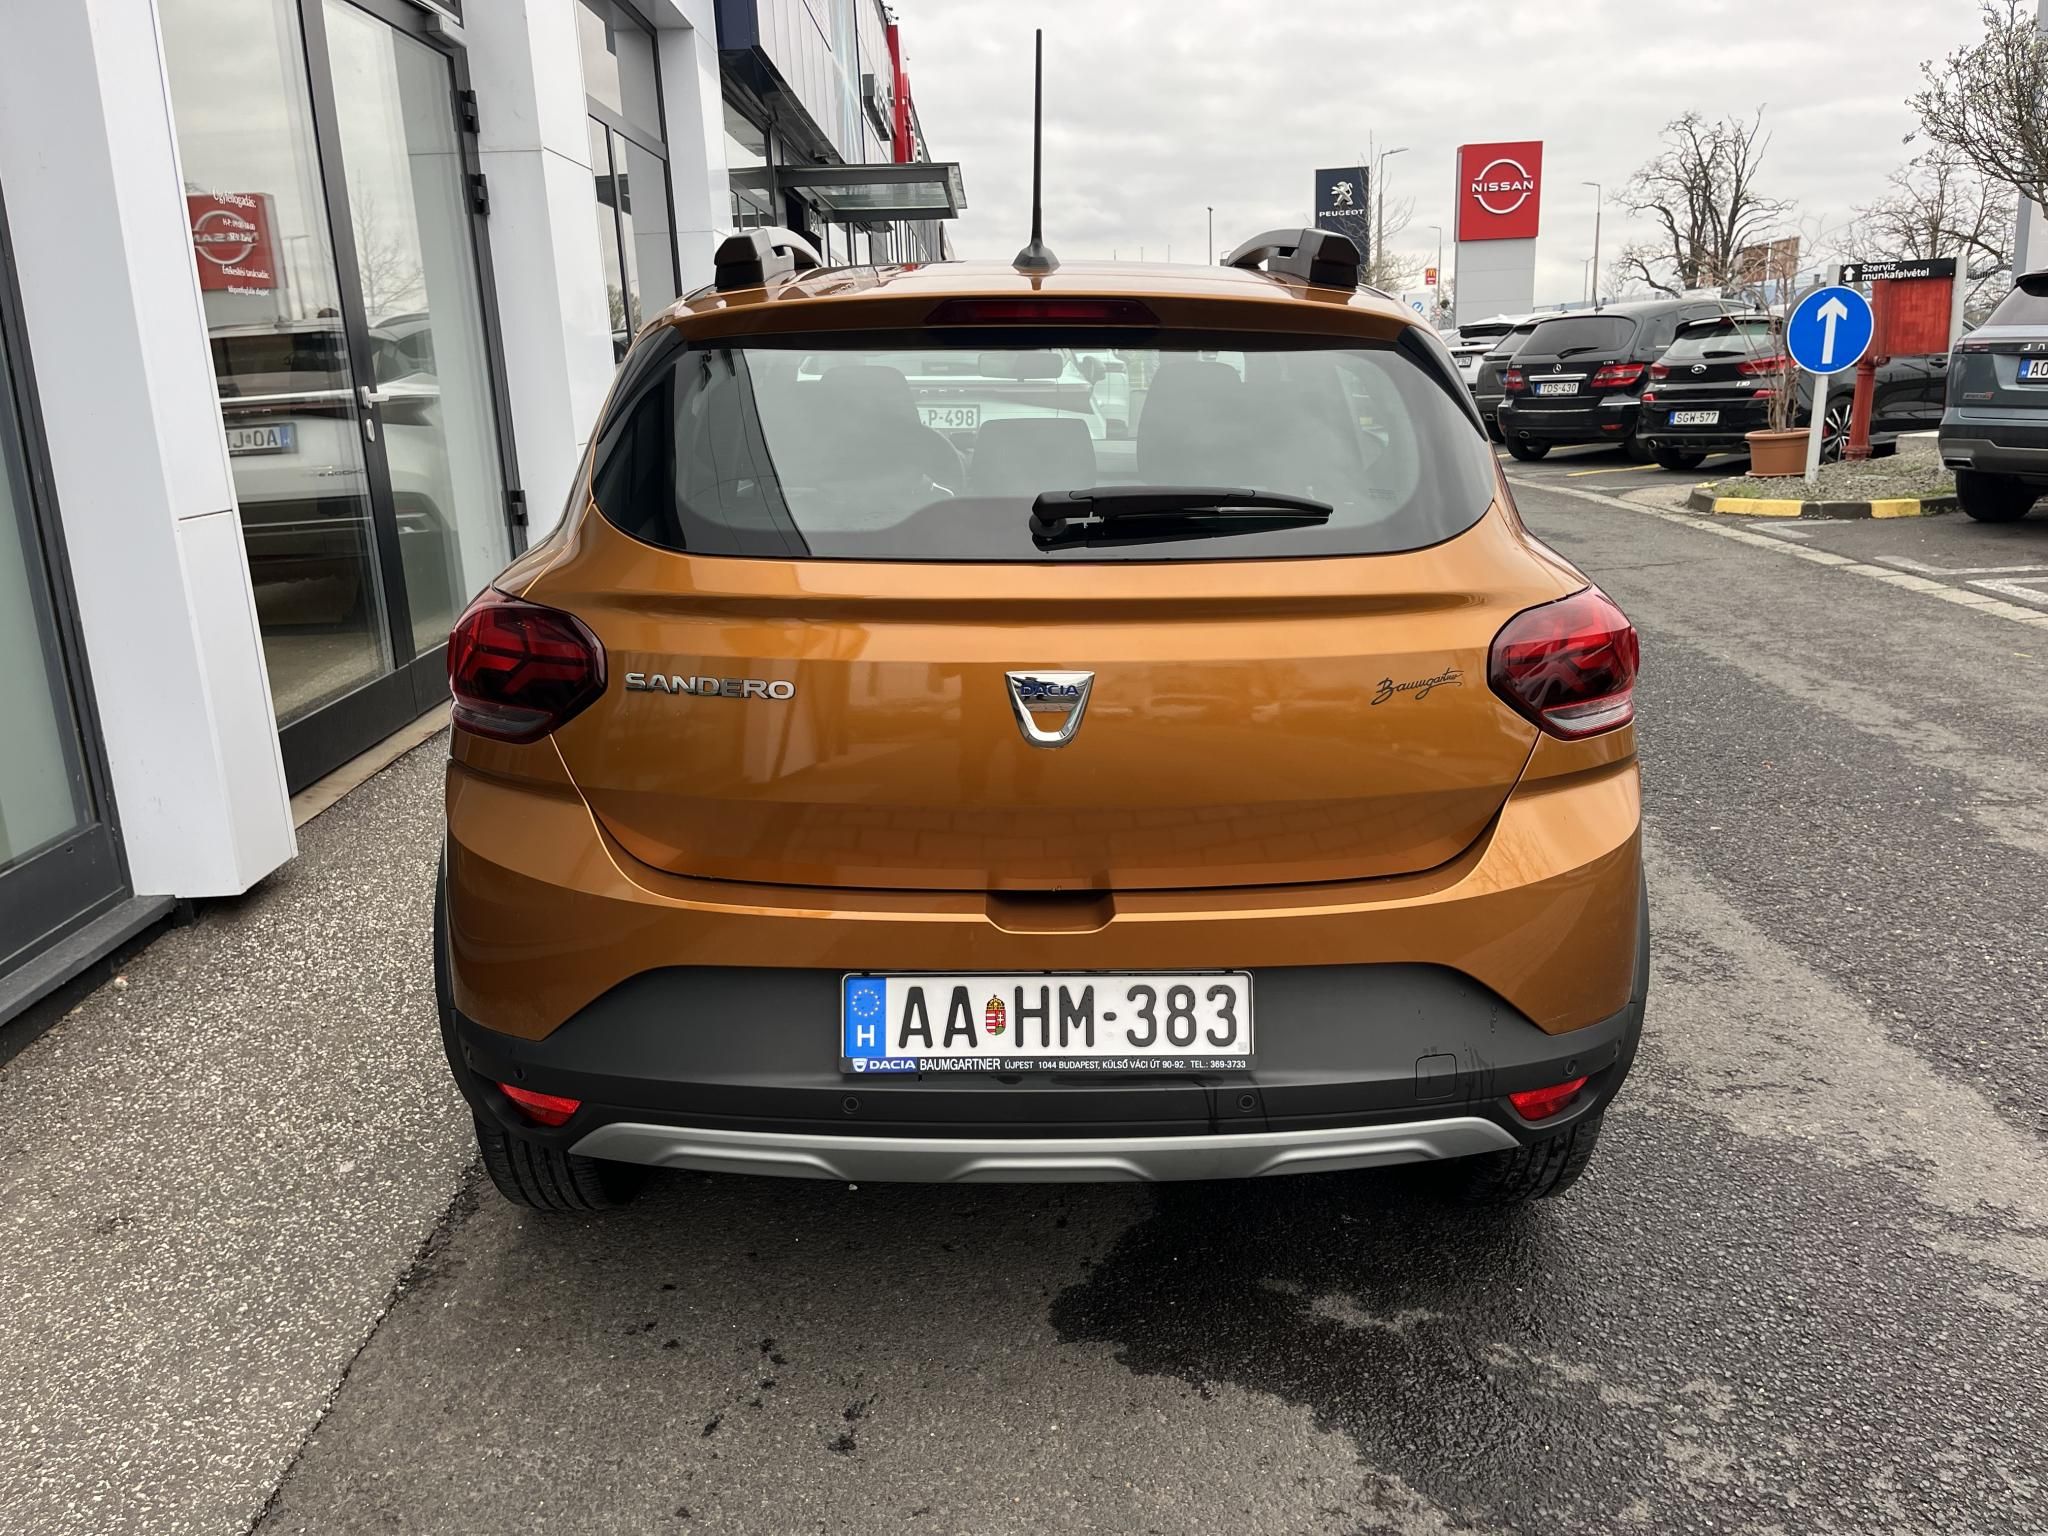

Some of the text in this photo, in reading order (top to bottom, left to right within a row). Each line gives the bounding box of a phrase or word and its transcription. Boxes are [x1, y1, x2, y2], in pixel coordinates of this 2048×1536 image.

[1472, 180, 1534, 193] NISSAN
[1319, 209, 1365, 217] PEUGEOT
[1861, 262, 1896, 273] Szerviz
[1861, 268, 1930, 281] munkafelvétel
[1543, 383, 1577, 393] TDS-430
[1676, 412, 1718, 423] SGW-577
[625, 672, 796, 700] SANDERO
[1019, 684, 1080, 697] DACIA
[898, 984, 1238, 1049] AA HM-383
[857, 1024, 875, 1048] H
[869, 1058, 1247, 1071] DACIA BAUMGARTNER ÚJPEST 1044 BUDAPEST, KÜLSŐ VÁCI ÚT 90-92. TEL.: 369-3733
